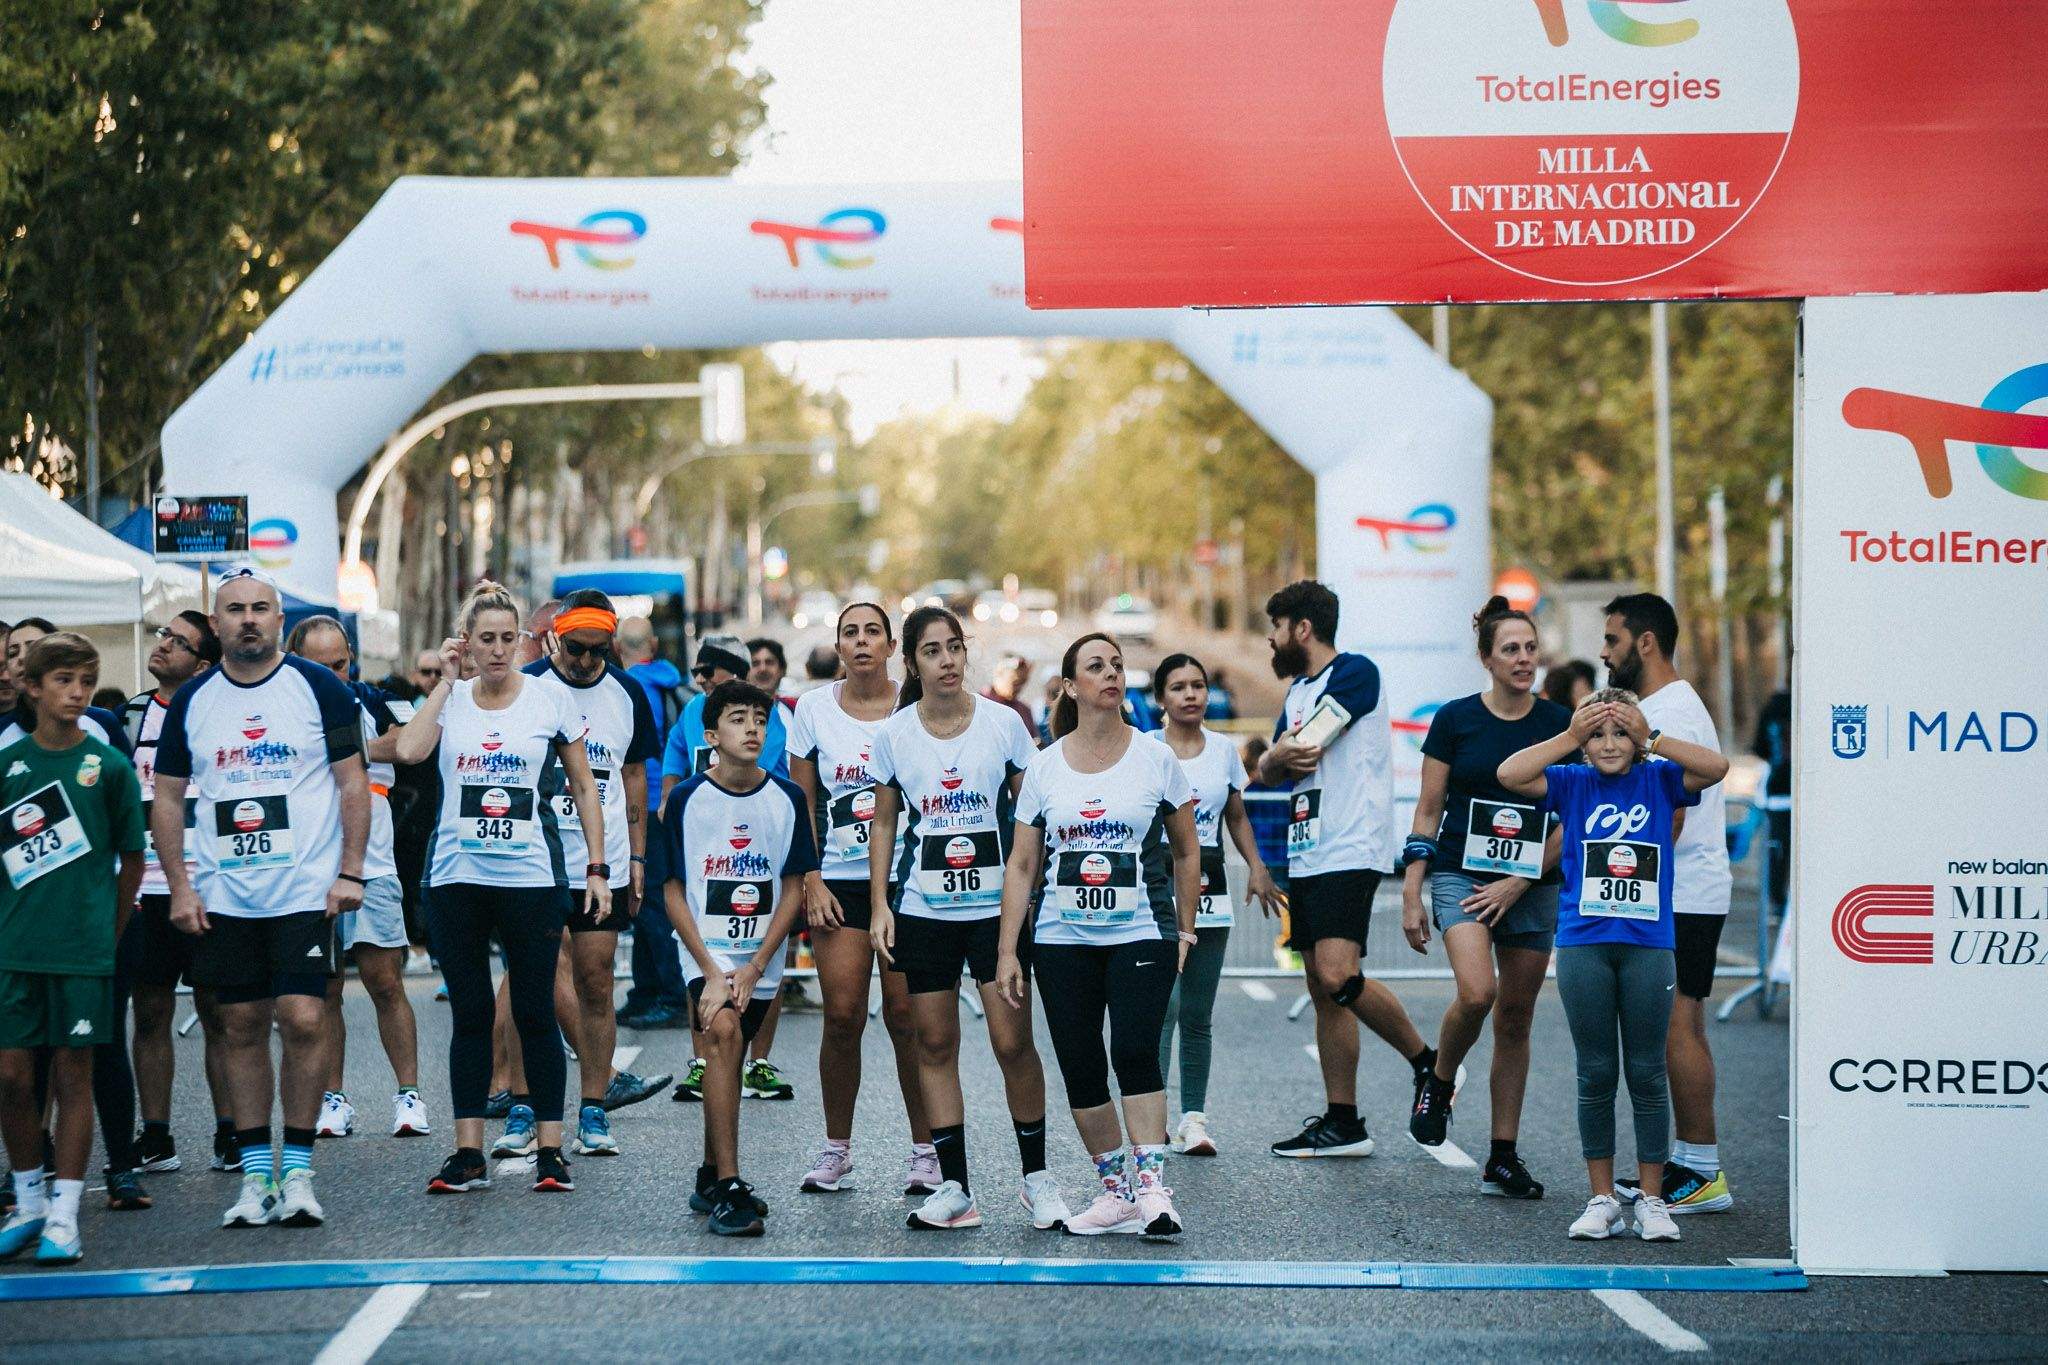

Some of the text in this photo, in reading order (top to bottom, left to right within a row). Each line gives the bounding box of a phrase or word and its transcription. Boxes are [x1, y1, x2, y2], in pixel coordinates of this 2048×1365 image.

[1475, 70, 1721, 108] TotalEnergies
[1537, 146, 1653, 174] MILLA
[1494, 218, 1696, 247] DE MADRID
[1840, 530, 2048, 570] TotalEner
[1909, 711, 2048, 752] MAD
[476, 818, 513, 840] 343
[20, 828, 63, 864] 323
[233, 832, 272, 857] 326
[1486, 837, 1523, 861] 307
[943, 868, 980, 892] 316
[1948, 861, 1987, 874] new
[1076, 887, 1116, 910] 300
[1600, 878, 1641, 903] 306
[1948, 885, 2048, 919] MIL
[727, 916, 758, 939] 317
[1668, 1179, 1700, 1202] HOKA
